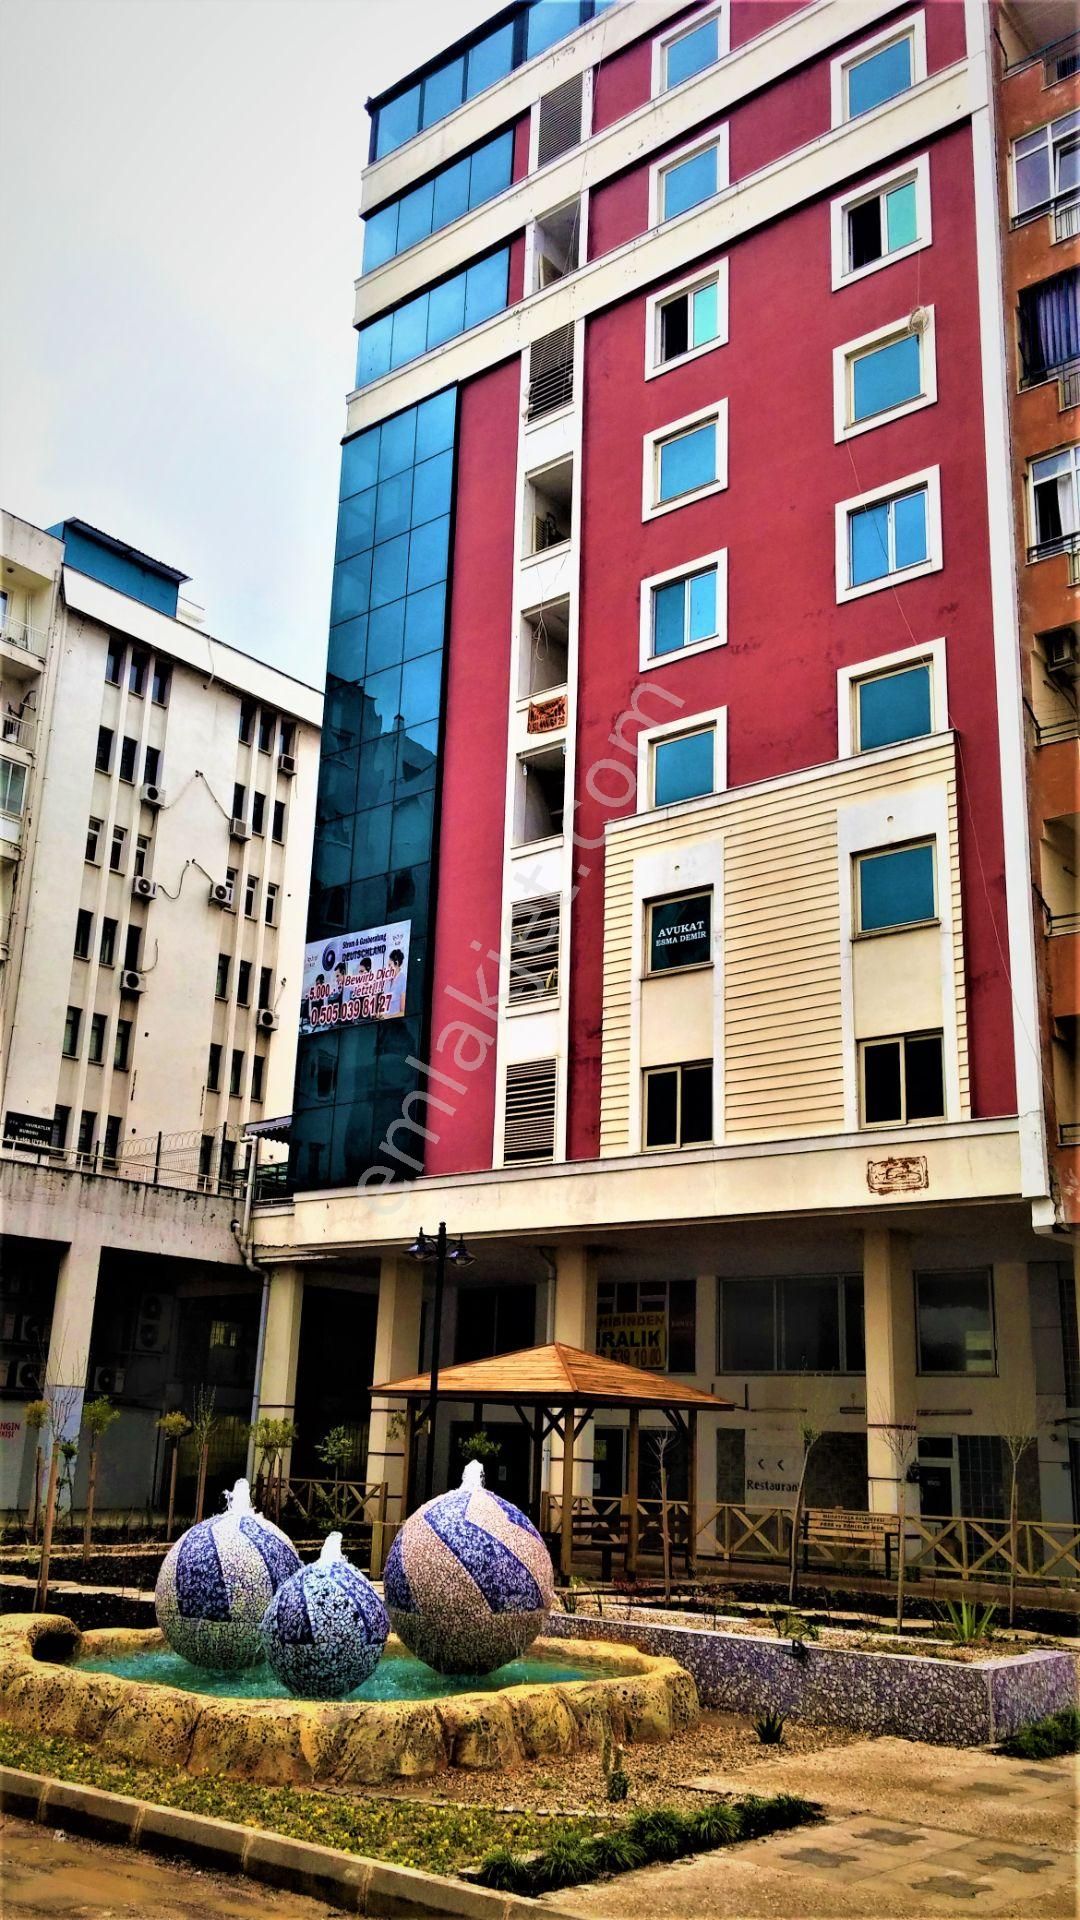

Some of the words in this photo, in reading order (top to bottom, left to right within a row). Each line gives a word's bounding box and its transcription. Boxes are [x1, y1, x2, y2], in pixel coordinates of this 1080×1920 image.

[657, 921, 705, 937] AVUKAT
[655, 938, 678, 947] ESMA
[680, 931, 706, 942] DEMİR
[341, 944, 387, 962] DEUTSCHLAND
[345, 971, 374, 986] Bewirb
[376, 967, 395, 980] Dich
[311, 1008, 318, 1026] 0
[320, 1004, 338, 1024] 505
[341, 1000, 360, 1020] 039
[363, 997, 375, 1016] 81
[379, 994, 392, 1013] 27
